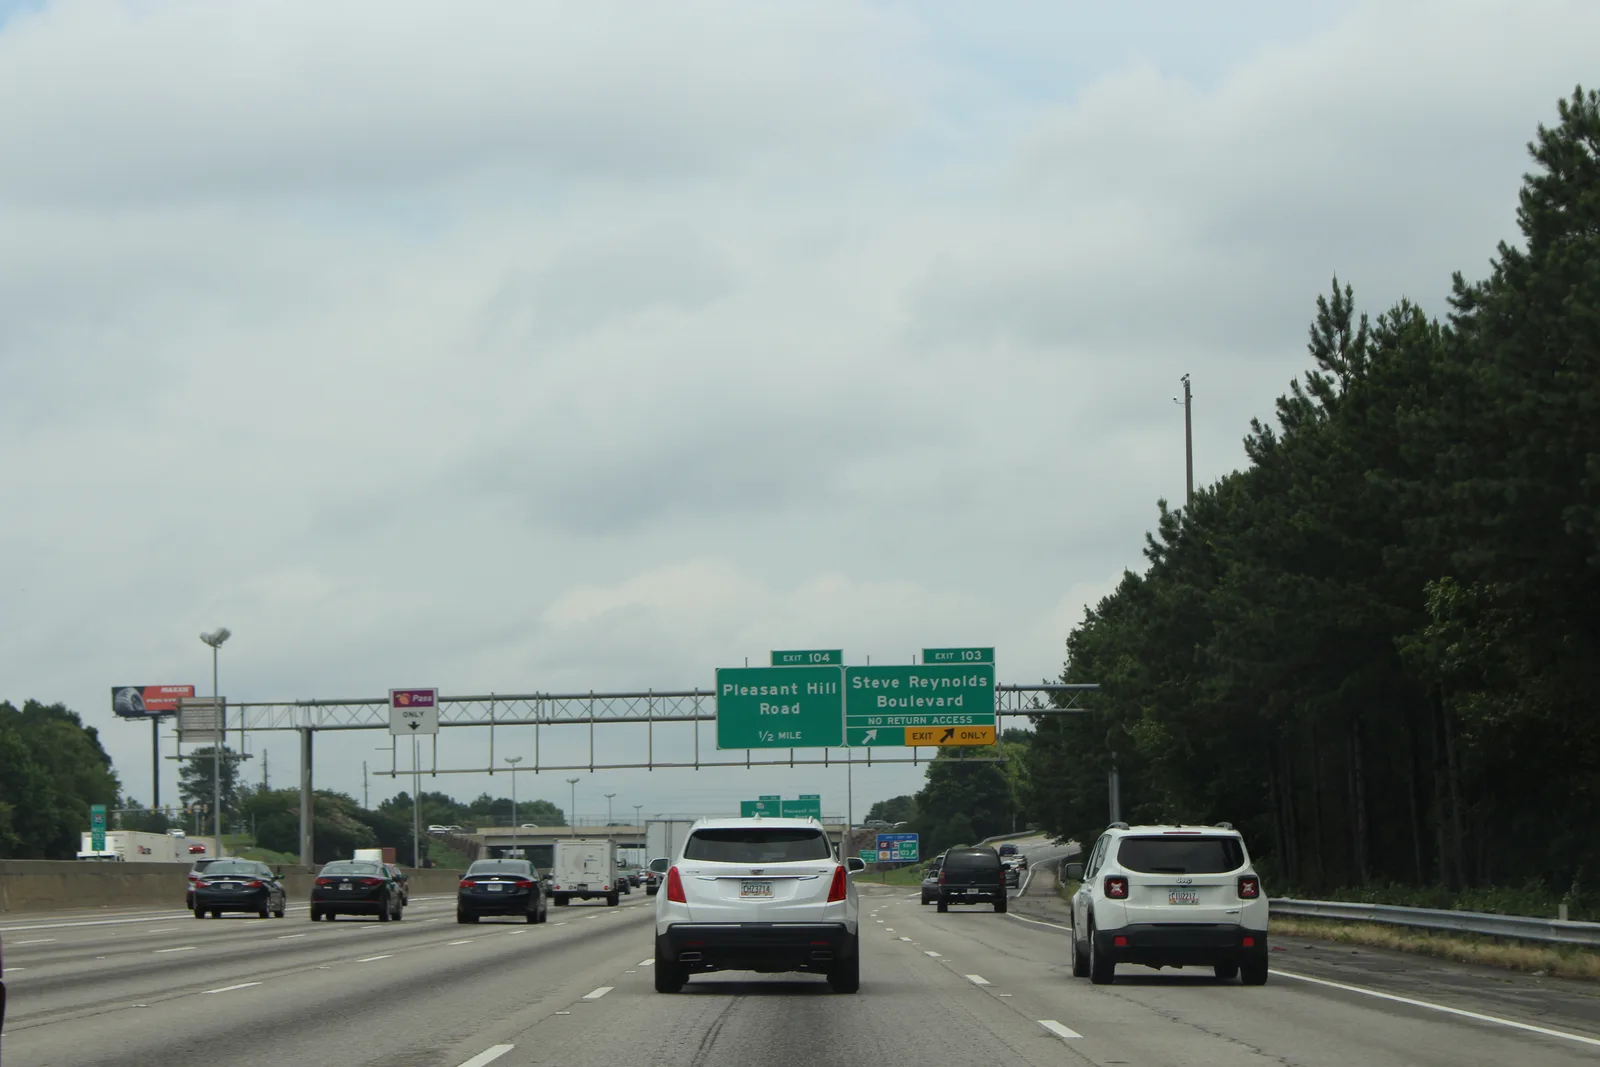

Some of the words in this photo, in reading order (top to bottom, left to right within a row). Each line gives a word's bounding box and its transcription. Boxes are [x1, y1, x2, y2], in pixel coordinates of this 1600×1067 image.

[783, 654, 803, 662] EXIT
[808, 652, 830, 663] 104
[934, 652, 955, 661] EXIT
[961, 650, 982, 661] 103
[852, 676, 900, 689] Steve
[909, 674, 988, 691] Reynolds
[723, 683, 798, 696] Pleasant
[807, 681, 836, 695] Hill
[412, 694, 433, 703] Pass
[877, 694, 964, 708] Boulevard
[760, 702, 801, 715] Road
[868, 717, 882, 725] NO
[887, 716, 927, 725] RETURN
[932, 715, 973, 724] ACCESS
[778, 731, 802, 740] MILE
[912, 732, 933, 741] EXIT
[960, 731, 987, 740] ONLY
